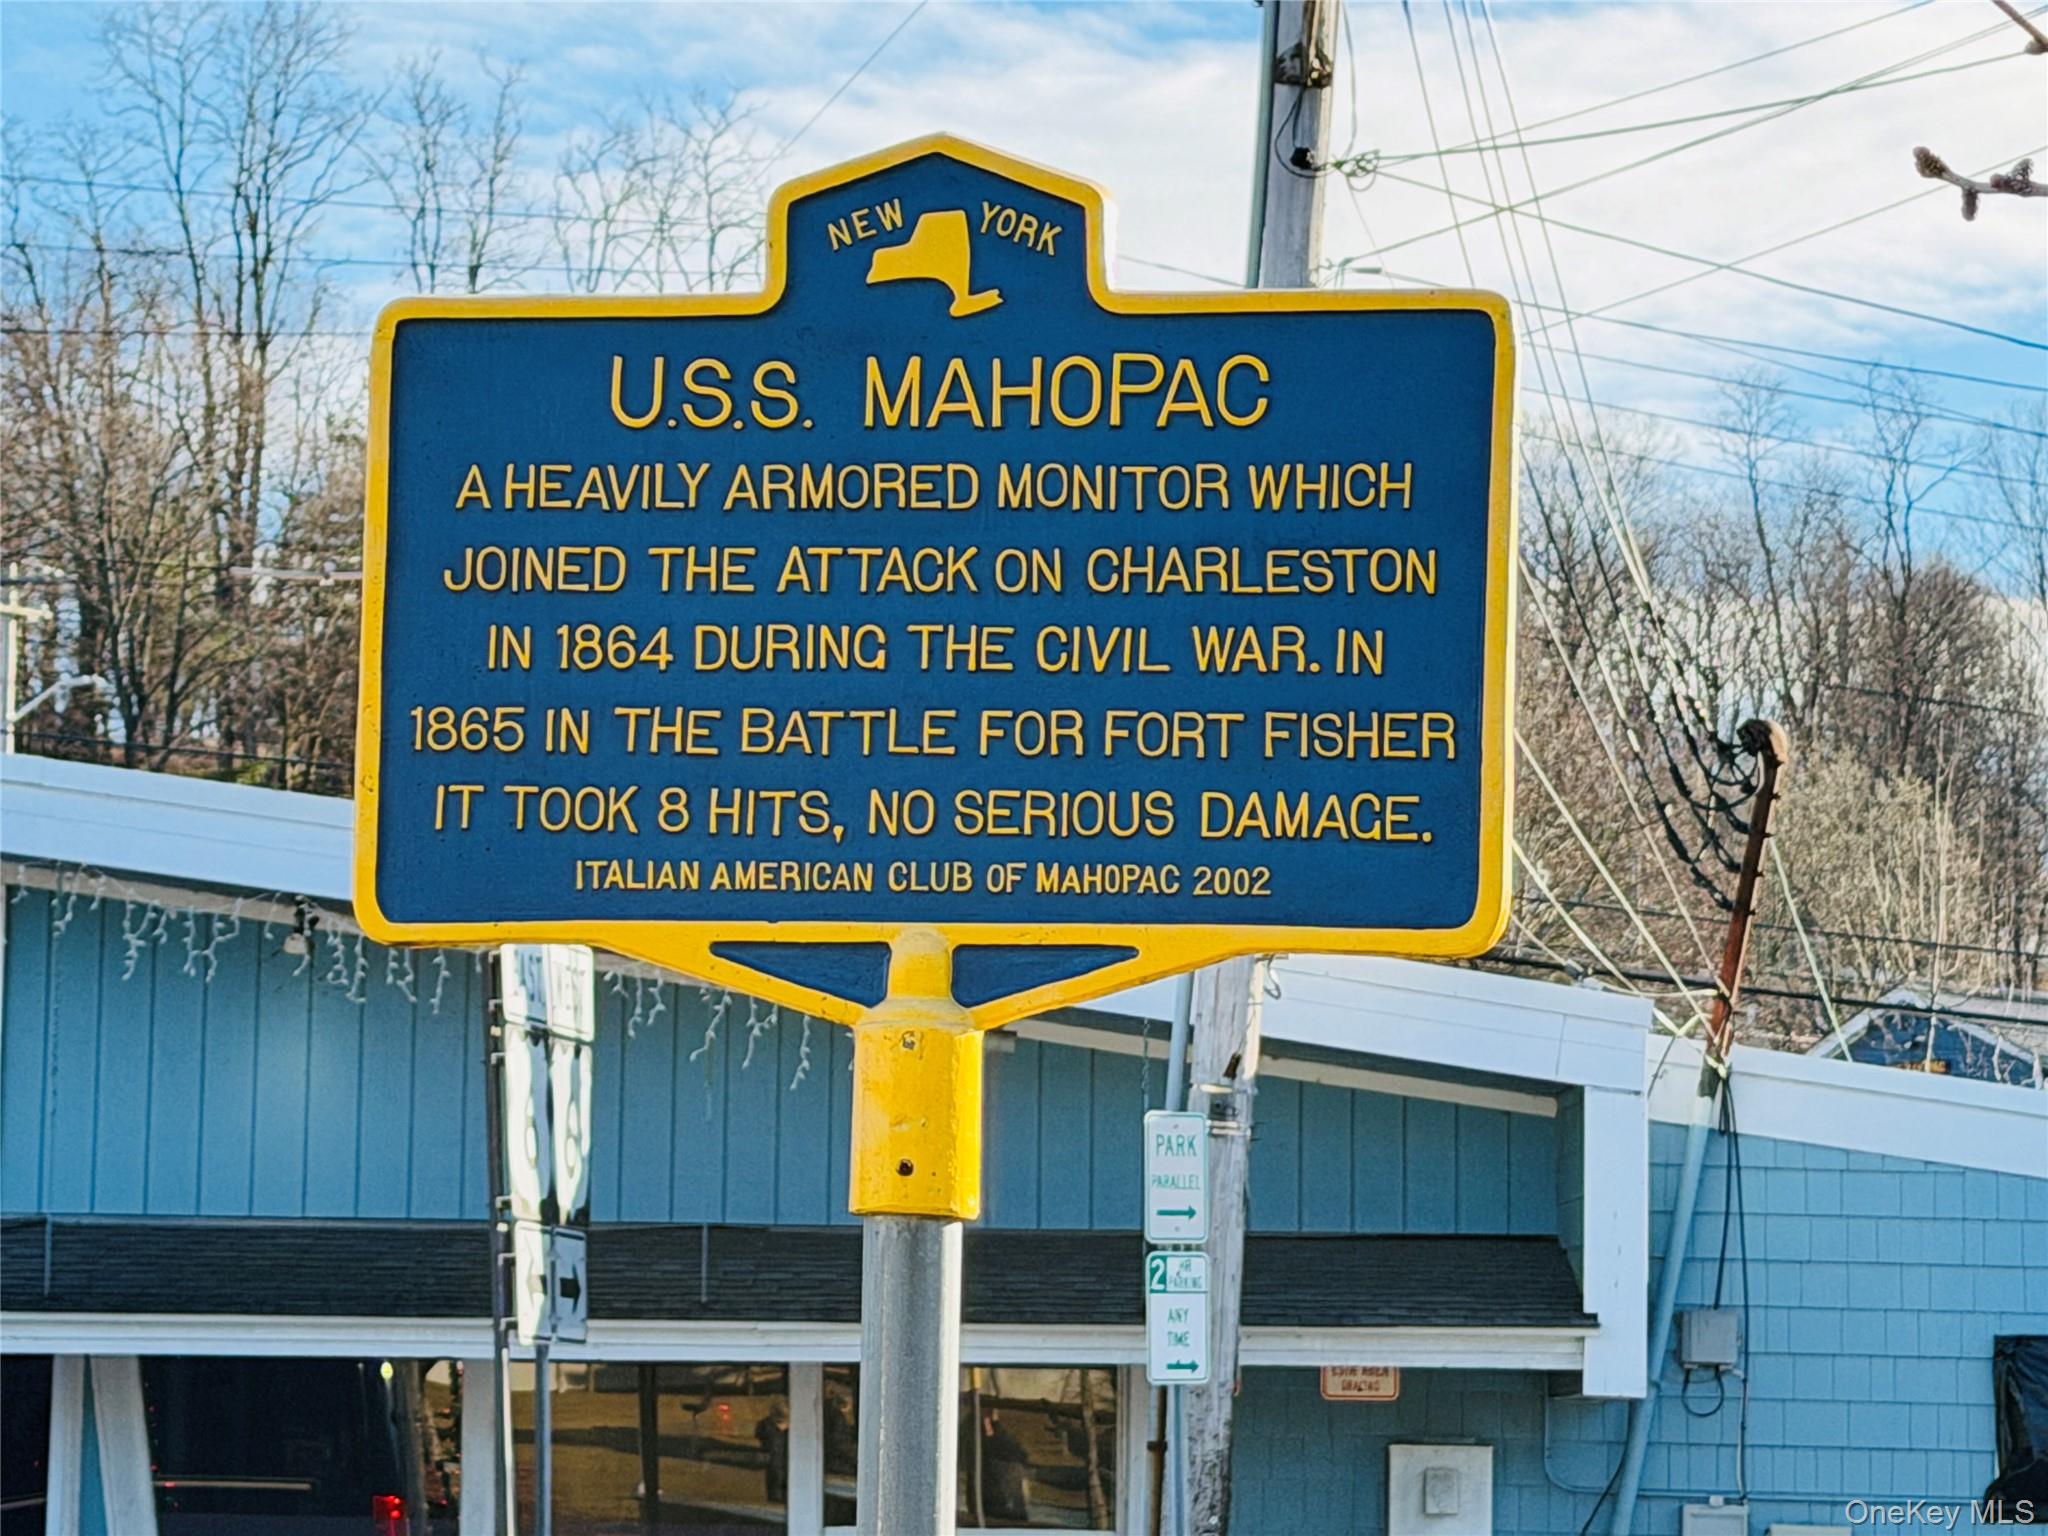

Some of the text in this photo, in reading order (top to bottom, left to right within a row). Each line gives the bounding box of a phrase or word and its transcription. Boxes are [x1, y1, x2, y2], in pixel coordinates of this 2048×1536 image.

[827, 198, 1063, 256] NEW YORK
[610, 352, 1271, 430] U.S.S. MAHOPAC
[456, 463, 1413, 512] A HEAVILY ARMORED MONITOR WHICH
[443, 546, 1437, 595] JOINED THE ATTACK ON CHARLESTON
[487, 623, 1384, 675] IN 1864 DURING THE CIVIL WAR. IN
[412, 706, 1456, 760] 1865 IN THE BATTLE FOR FORT FISHER
[434, 784, 1434, 843] IT TOOK 8 HITS, NO SERIOUS DAMAGE.
[575, 860, 1270, 896] ITALIAN AMERICAN CLUB OF MAHOPAC 2002
[1156, 1133, 1197, 1157] PARK
[1151, 1173, 1201, 1190] PARALLEL
[1151, 1258, 1166, 1291] 2
[1167, 1307, 1190, 1324] ANY
[1167, 1330, 1191, 1348] TIME
